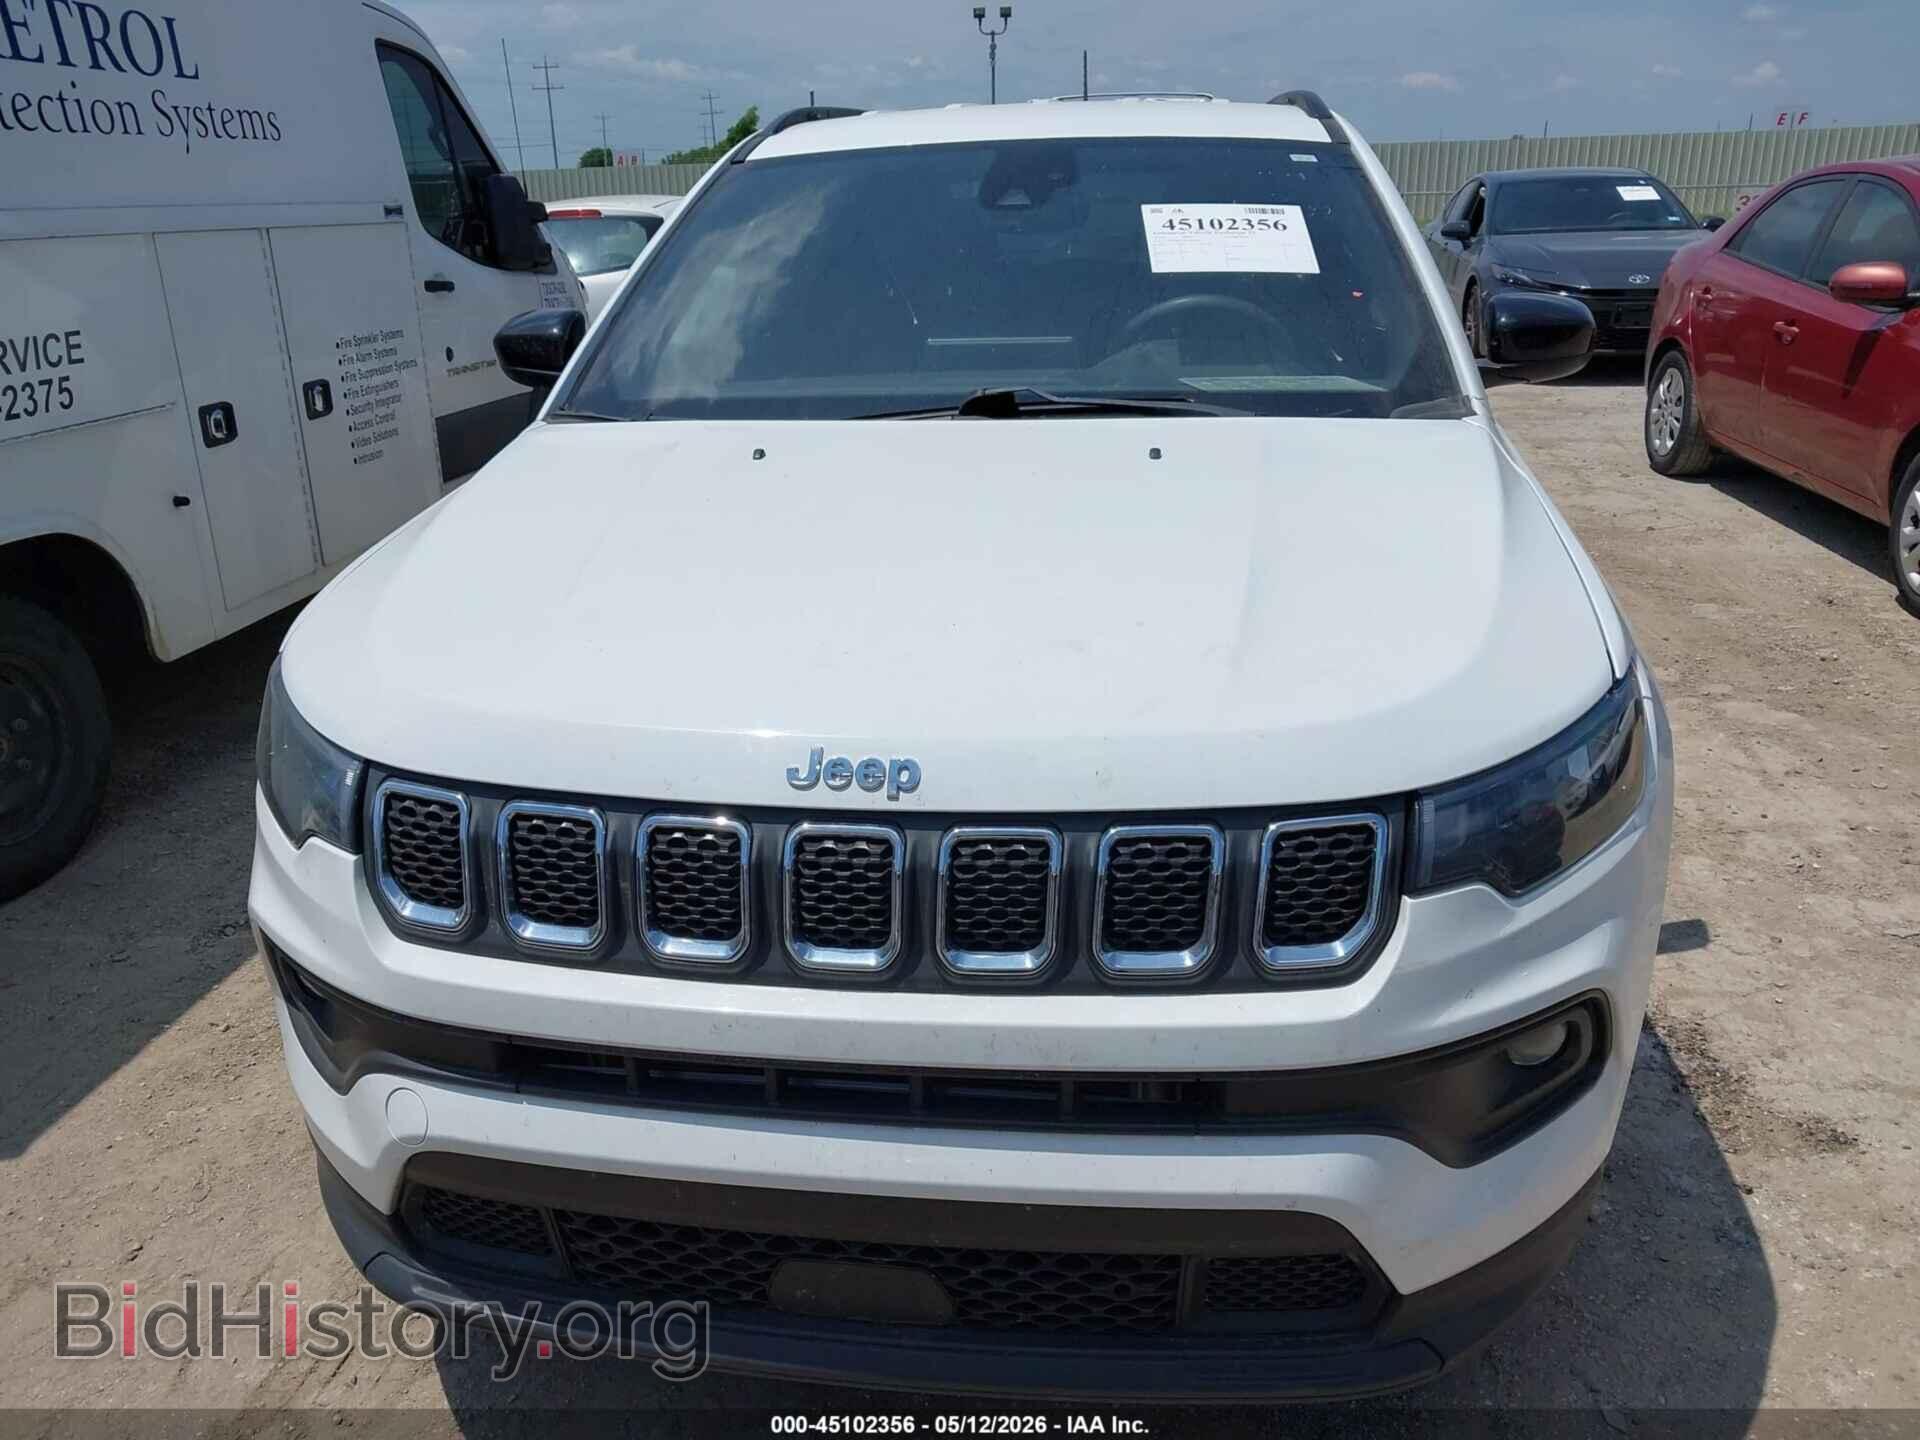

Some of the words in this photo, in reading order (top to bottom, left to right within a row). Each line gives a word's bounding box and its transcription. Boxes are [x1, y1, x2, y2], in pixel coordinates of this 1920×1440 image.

[151, 89, 281, 154] Systems
[1776, 112, 1788, 126] E
[1797, 112, 1809, 125] F
[1162, 218, 1288, 232] 45102356
[339, 337, 352, 350] Fire
[0, 330, 85, 375] RVICE
[342, 353, 354, 366] Fire
[345, 371, 358, 383] Fire
[0, 375, 74, 421] 2375
[347, 387, 359, 400] Fire
[786, 744, 922, 802] Jeep
